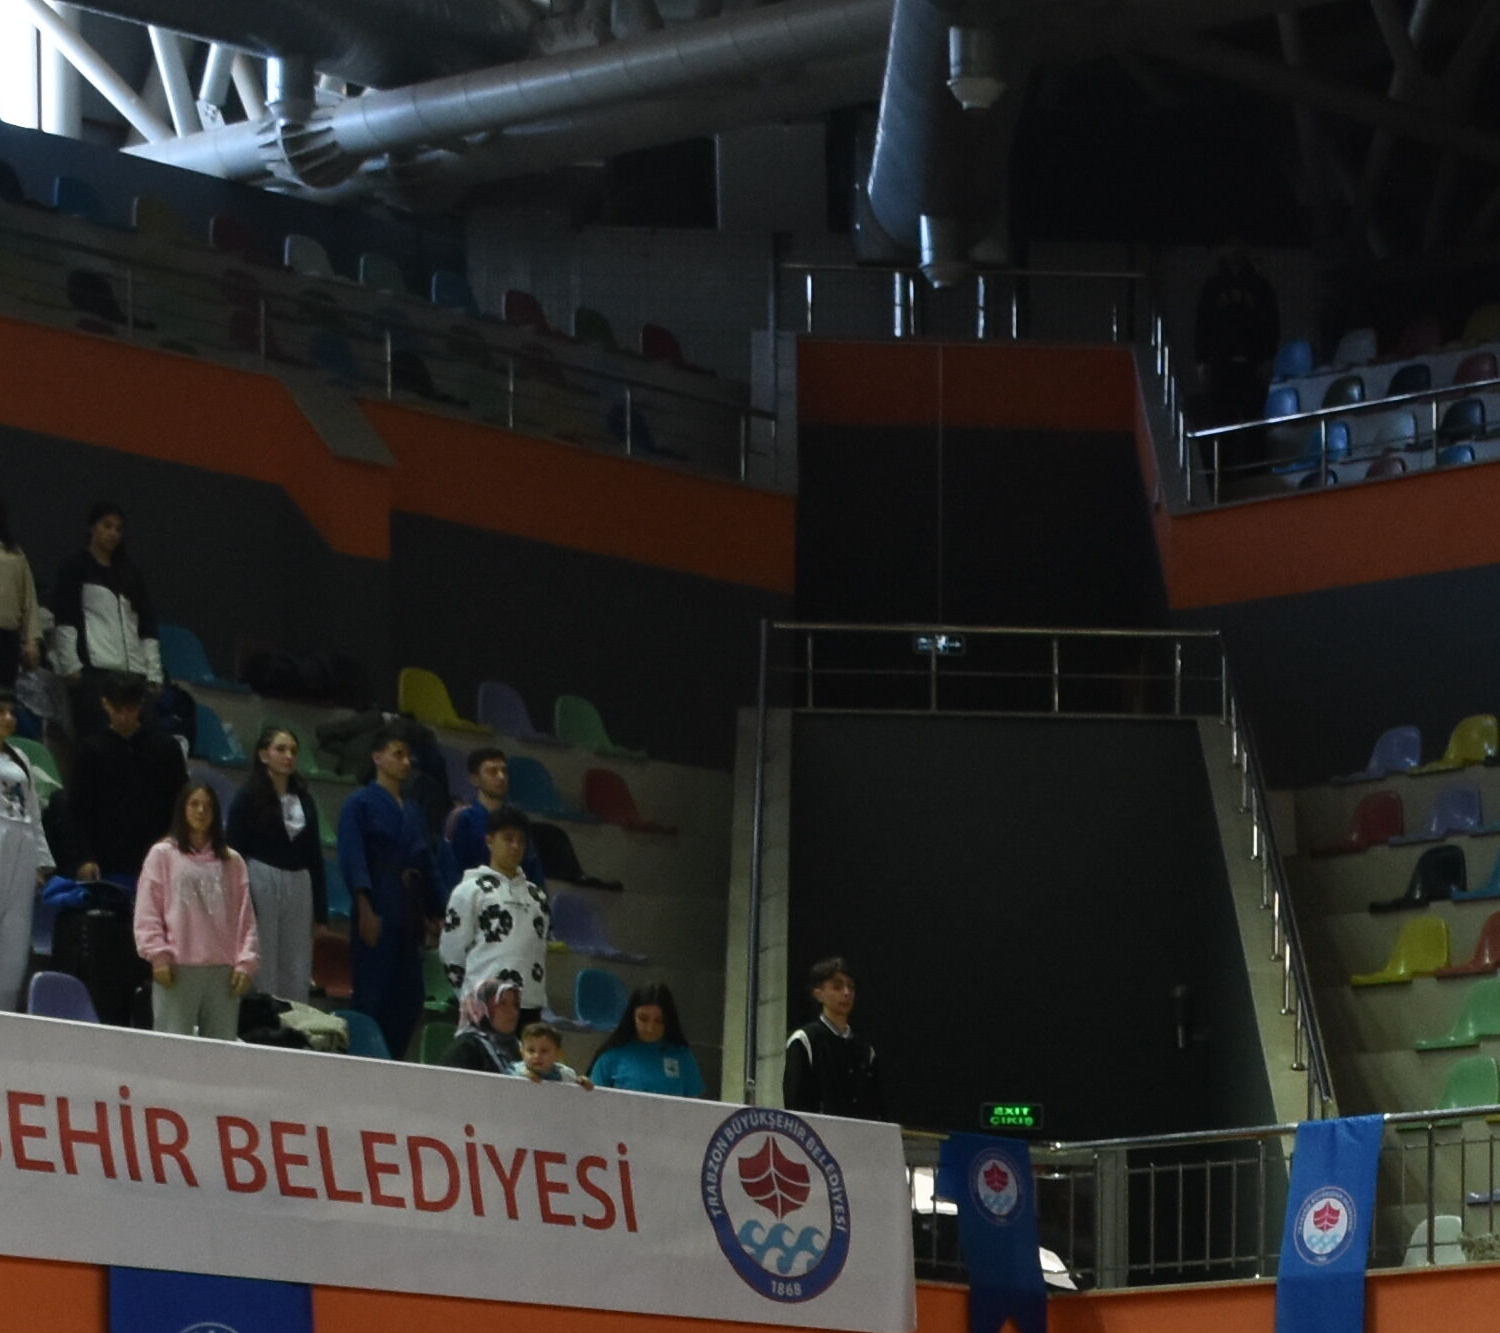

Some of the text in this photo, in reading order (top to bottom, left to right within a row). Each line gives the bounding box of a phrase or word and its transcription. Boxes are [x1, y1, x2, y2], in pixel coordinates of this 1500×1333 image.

[994, 1107, 1030, 1115] EXIT
[216, 1113, 638, 1234] BELEDİYESİ
[771, 1280, 802, 1296] 1868
